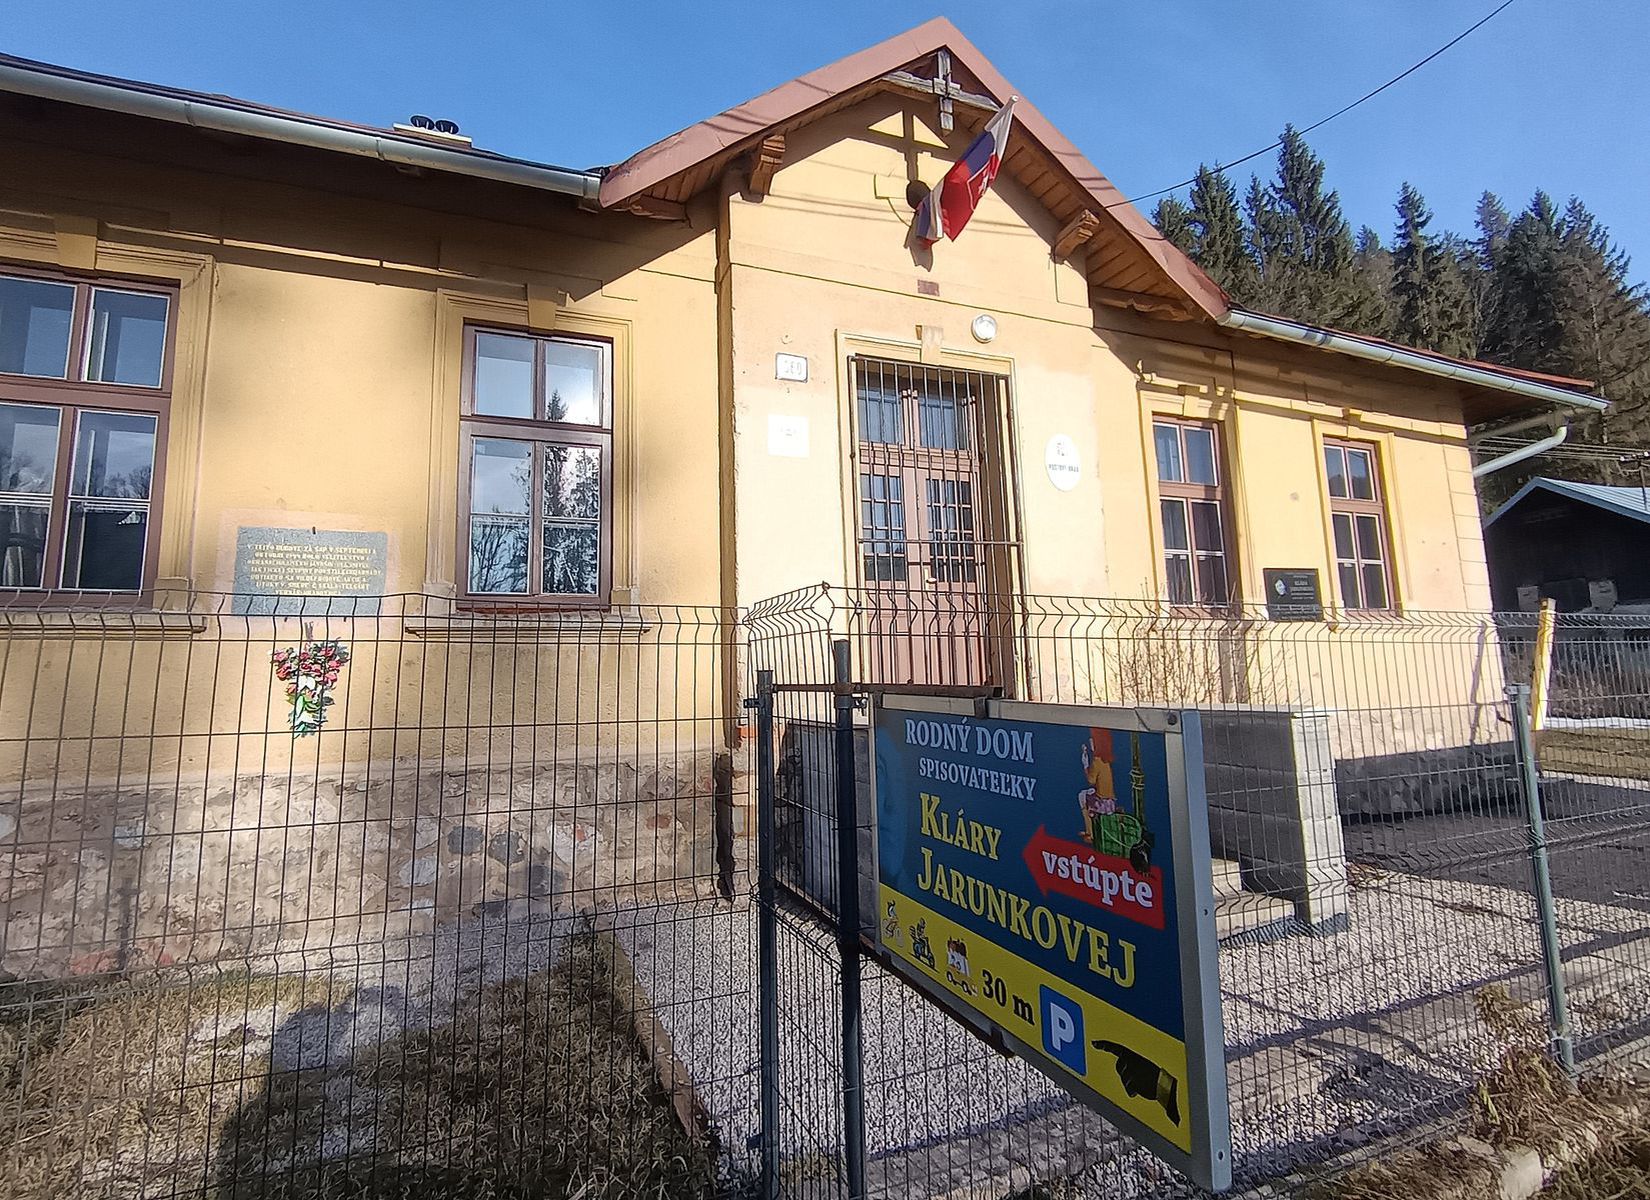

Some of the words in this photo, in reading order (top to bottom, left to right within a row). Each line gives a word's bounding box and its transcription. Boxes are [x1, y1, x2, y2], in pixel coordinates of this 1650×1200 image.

[905, 716, 971, 753] RODNÝ
[975, 726, 1035, 763] DOM
[919, 757, 1037, 801] SPISOVATEĽKY
[1041, 849, 1153, 908] vstúpte
[981, 968, 1007, 1008] 30
[1013, 992, 1036, 1026] m
[1049, 1001, 1076, 1053] P
